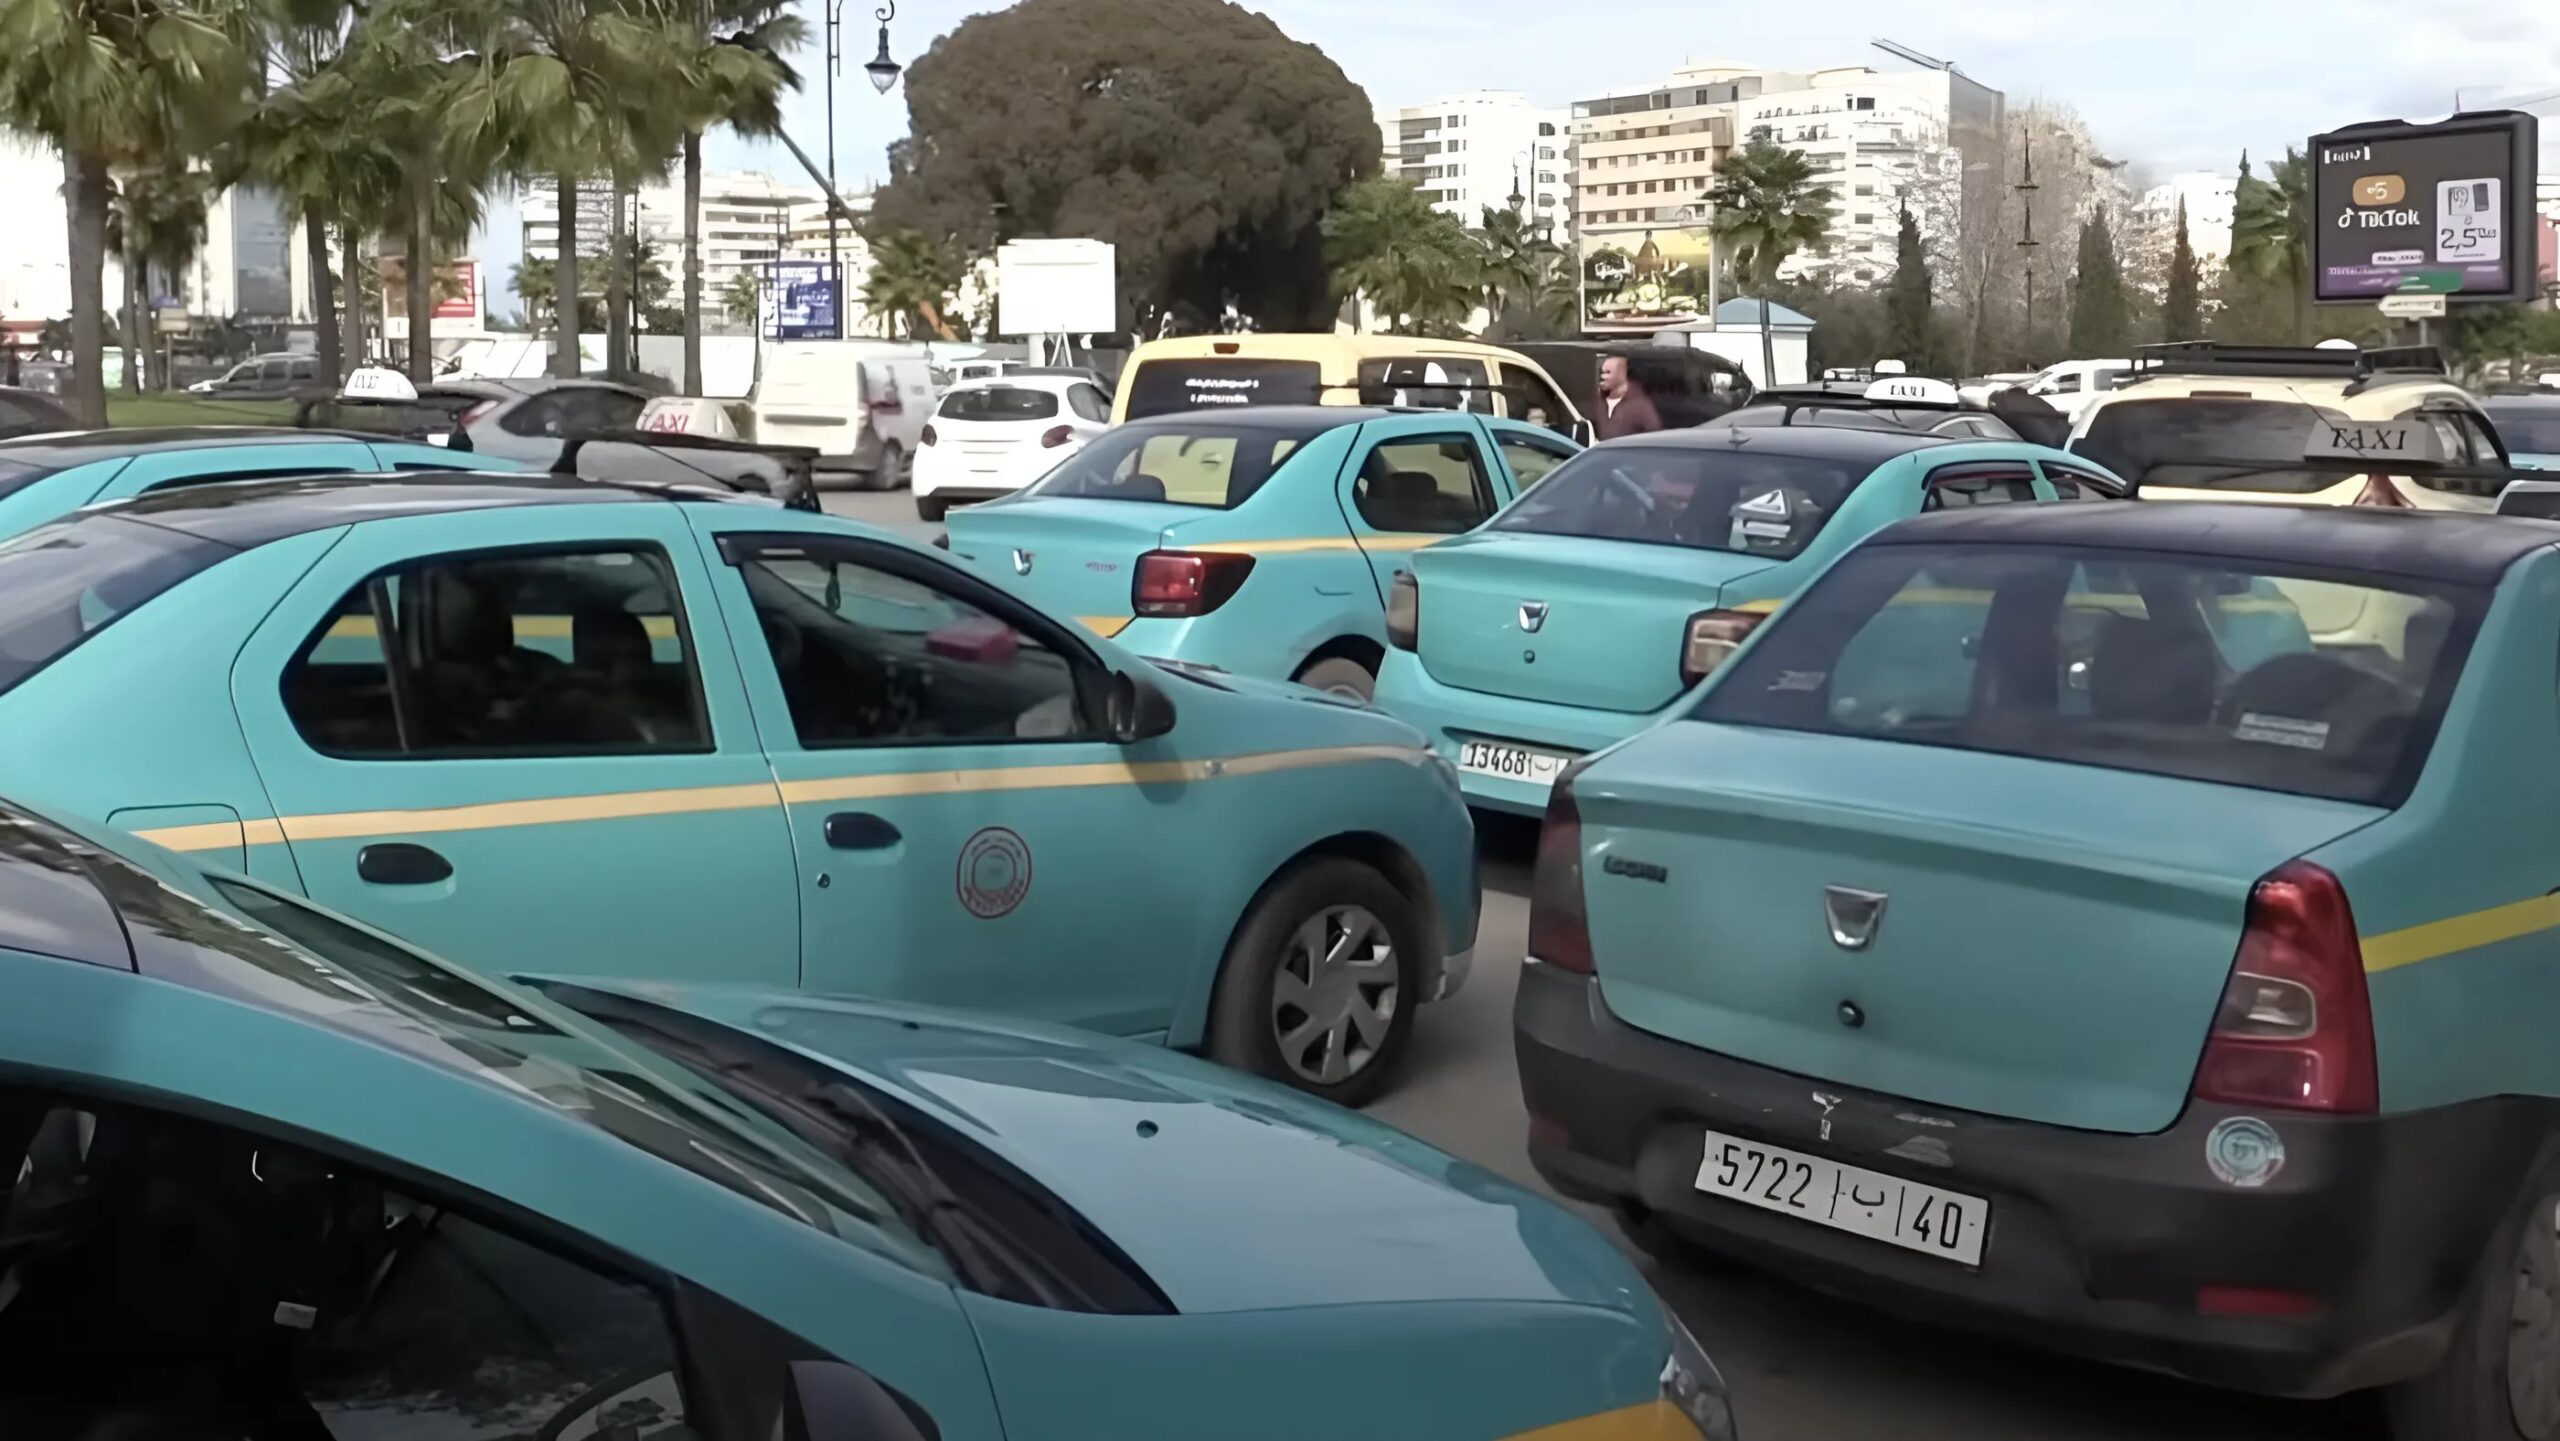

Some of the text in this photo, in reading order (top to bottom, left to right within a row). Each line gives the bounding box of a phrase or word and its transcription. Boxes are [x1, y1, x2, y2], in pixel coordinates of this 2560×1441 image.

[2331, 427, 2407, 450] TAXI
[1464, 743, 1526, 774] 13468
[1717, 1143, 1812, 1208] 5722
[1913, 1195, 1962, 1248] 40
